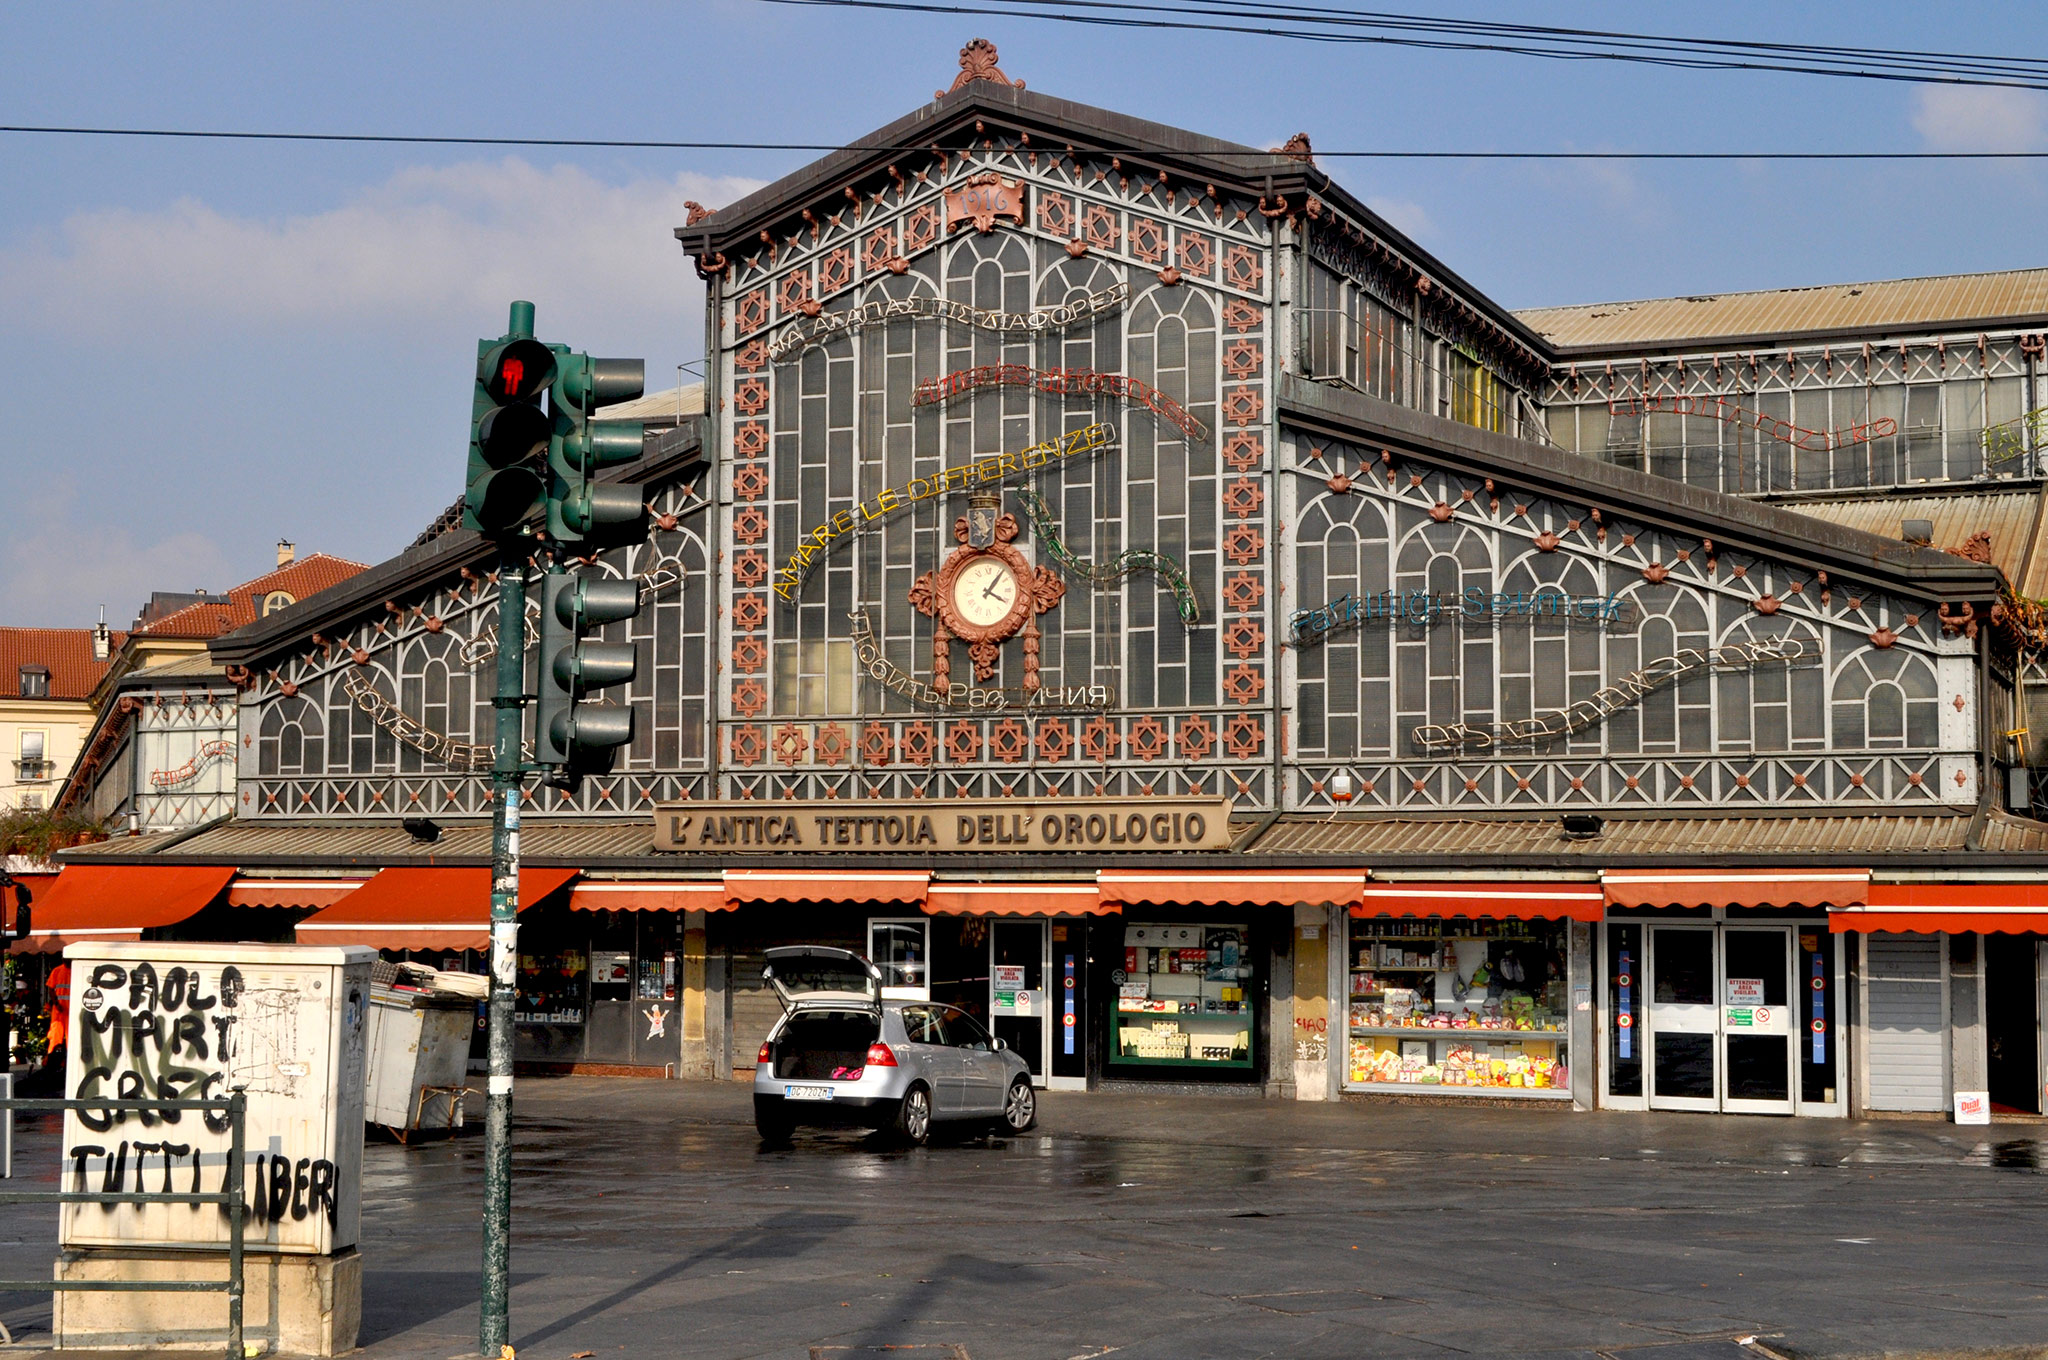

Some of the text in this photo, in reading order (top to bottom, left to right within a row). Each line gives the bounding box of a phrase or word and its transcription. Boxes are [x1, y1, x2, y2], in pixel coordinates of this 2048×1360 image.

[960, 188, 1008, 214] 1916
[772, 421, 1106, 600] AMARE LE DIFFERENZE
[342, 676, 418, 742] LOVE
[814, 814, 938, 845] TETTOIA
[91, 961, 244, 1012] PAOLO
[1296, 1017, 1327, 1032] CIAO
[70, 1139, 202, 1216] TUTTI
